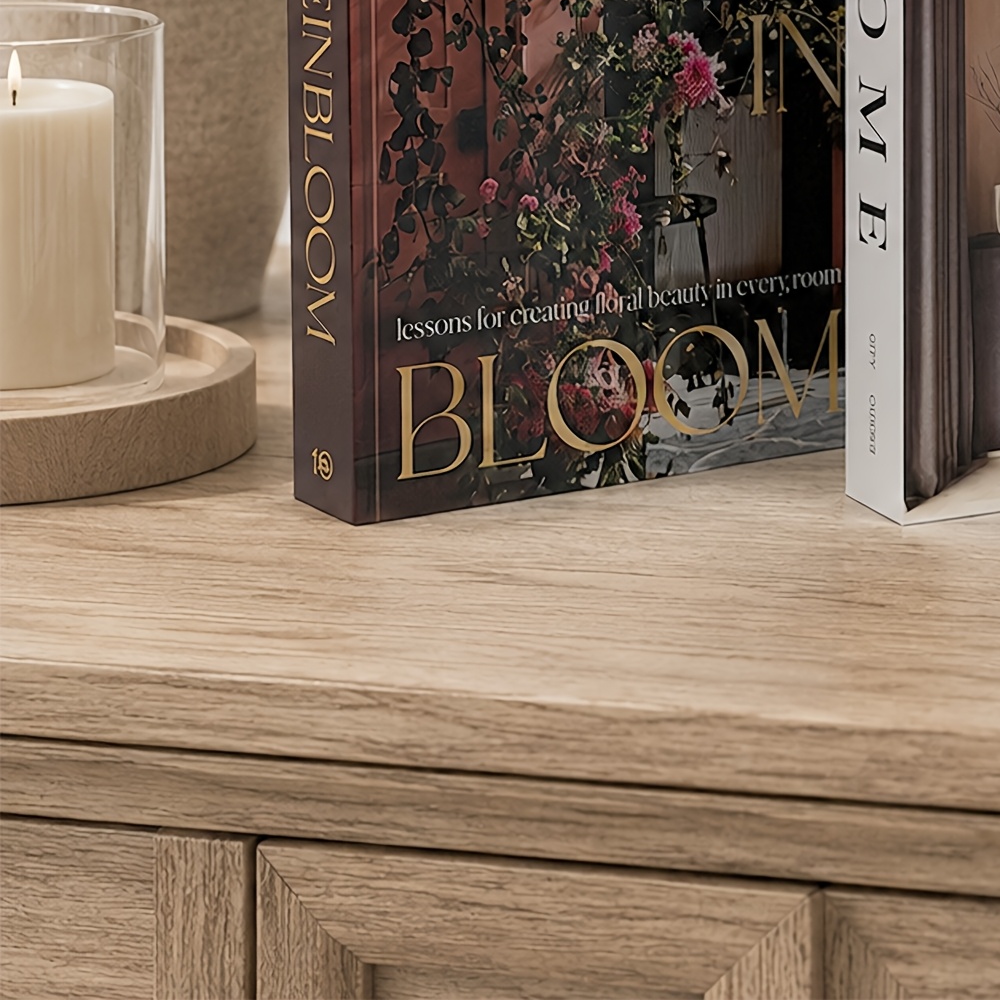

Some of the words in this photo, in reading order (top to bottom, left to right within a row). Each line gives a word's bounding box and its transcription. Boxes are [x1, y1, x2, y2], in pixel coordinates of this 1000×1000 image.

[748, 6, 841, 116] IN
[396, 313, 472, 342] lessons
[477, 305, 506, 331] for
[510, 296, 592, 326] creating
[595, 287, 643, 315] floral
[648, 283, 710, 309] beauty
[716, 278, 733, 300] in
[792, 267, 842, 290] room
[395, 309, 844, 481] BLOOM
